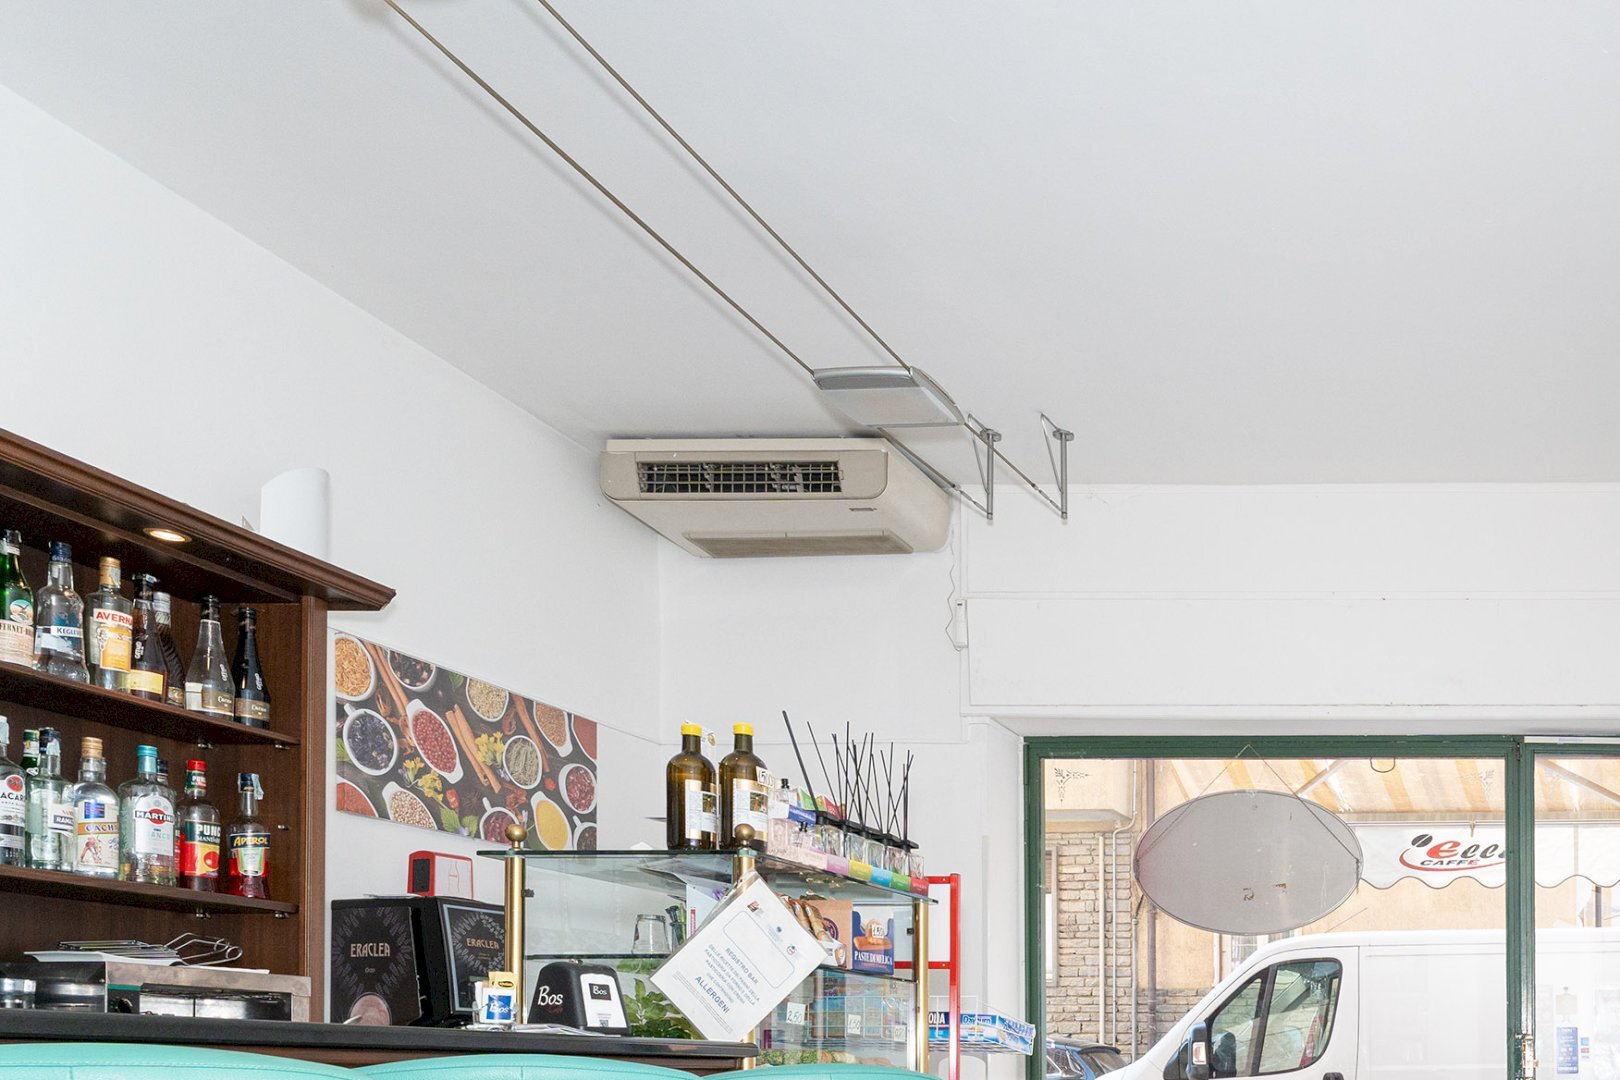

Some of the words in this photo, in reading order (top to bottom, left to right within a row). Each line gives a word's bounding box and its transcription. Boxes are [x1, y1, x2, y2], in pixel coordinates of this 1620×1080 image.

[234, 836, 268, 847] APEROL
[466, 938, 500, 949] ERACLEA
[351, 943, 391, 957] ERACLEA
[537, 985, 563, 1006] Bos
[592, 985, 607, 995] Bos
[694, 975, 730, 1013] ALLERGENI
